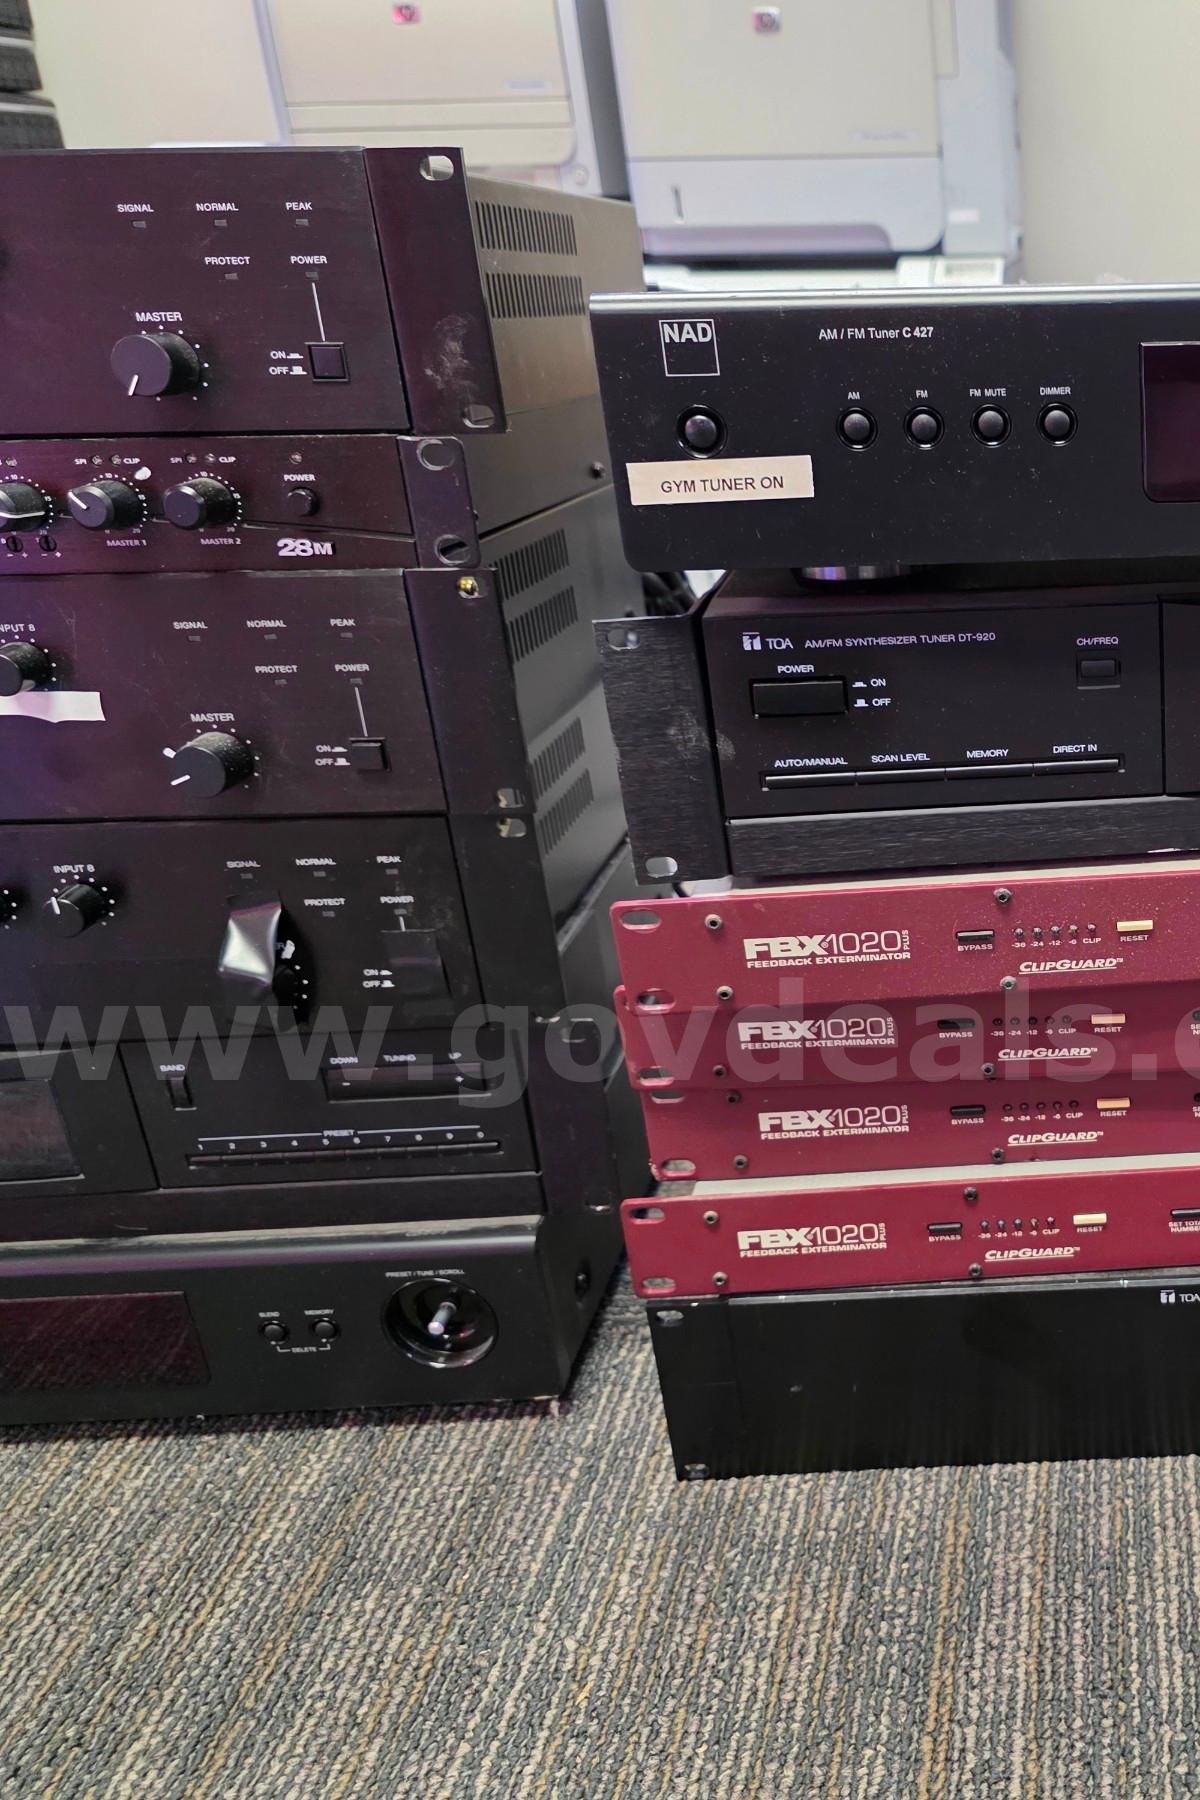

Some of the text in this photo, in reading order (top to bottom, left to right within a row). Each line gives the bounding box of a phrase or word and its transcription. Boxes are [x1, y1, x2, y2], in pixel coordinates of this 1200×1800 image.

[117, 203, 154, 213] SIGNAL
[196, 202, 239, 212] NORMAL
[285, 202, 313, 211] PEAK
[204, 256, 250, 266] PROTECT
[290, 255, 327, 265] POWER
[135, 312, 183, 322] MASTER
[663, 323, 713, 344] NAD
[819, 328, 837, 340] AM
[847, 328, 866, 340] FM
[867, 327, 900, 339] Tuner
[902, 328, 911, 338] C
[913, 326, 934, 338] 427
[270, 350, 287, 360] ON
[269, 366, 289, 376] OFF
[916, 390, 928, 400] FM
[969, 387, 1007, 398] FM MUTE
[1039, 386, 1071, 396] DIMMER
[847, 392, 861, 401] AM
[283, 474, 315, 482] POWER
[661, 476, 784, 495] GYM TUNER ON
[106, 539, 140, 547] MASTER
[200, 538, 233, 546] MASTER
[277, 538, 334, 557] 28M
[173, 621, 208, 631] SIGNAL
[246, 619, 287, 629] NORMAL
[330, 618, 355, 627] PEAK
[765, 632, 996, 650] TOA AM/FM SYNTHESIZER TUNER DT-920
[1076, 636, 1119, 647] CH/FREQ
[255, 665, 298, 674] PROTECT
[334, 663, 370, 672] POWER
[777, 664, 815, 674] POWER
[870, 678, 886, 687] ON
[872, 698, 891, 707] OFF
[190, 712, 235, 723] MASTER
[316, 744, 332, 753] ON
[966, 748, 1009, 759] MEMORY
[1052, 743, 1097, 754] DIRECT IN
[315, 758, 333, 766] OFF
[774, 756, 848, 768] AUTO/MANUAL
[871, 752, 930, 763] SCAN LEVEL
[227, 860, 260, 869] SIGNAL
[295, 858, 336, 866] NORMAL
[376, 855, 402, 864] PEAK
[53, 865, 84, 874] INPUT
[304, 898, 346, 907] PROTECT
[380, 895, 414, 904] POWER
[902, 929, 910, 950] PLUS
[1120, 934, 1149, 942] RESET
[957, 943, 993, 952] BYPASS
[747, 952, 911, 969] FEEDBACK EXTERMINATOR
[939, 1031, 974, 1039] BYPASS
[741, 1038, 896, 1050] FEEDBACK EXTERMINATOR
[761, 1125, 910, 1140] FEEDBACK EXTERMINATOR
[740, 1242, 887, 1258] FEEDBACK EXTERMINATOR
[1179, 1293, 1200, 1302] TOA
